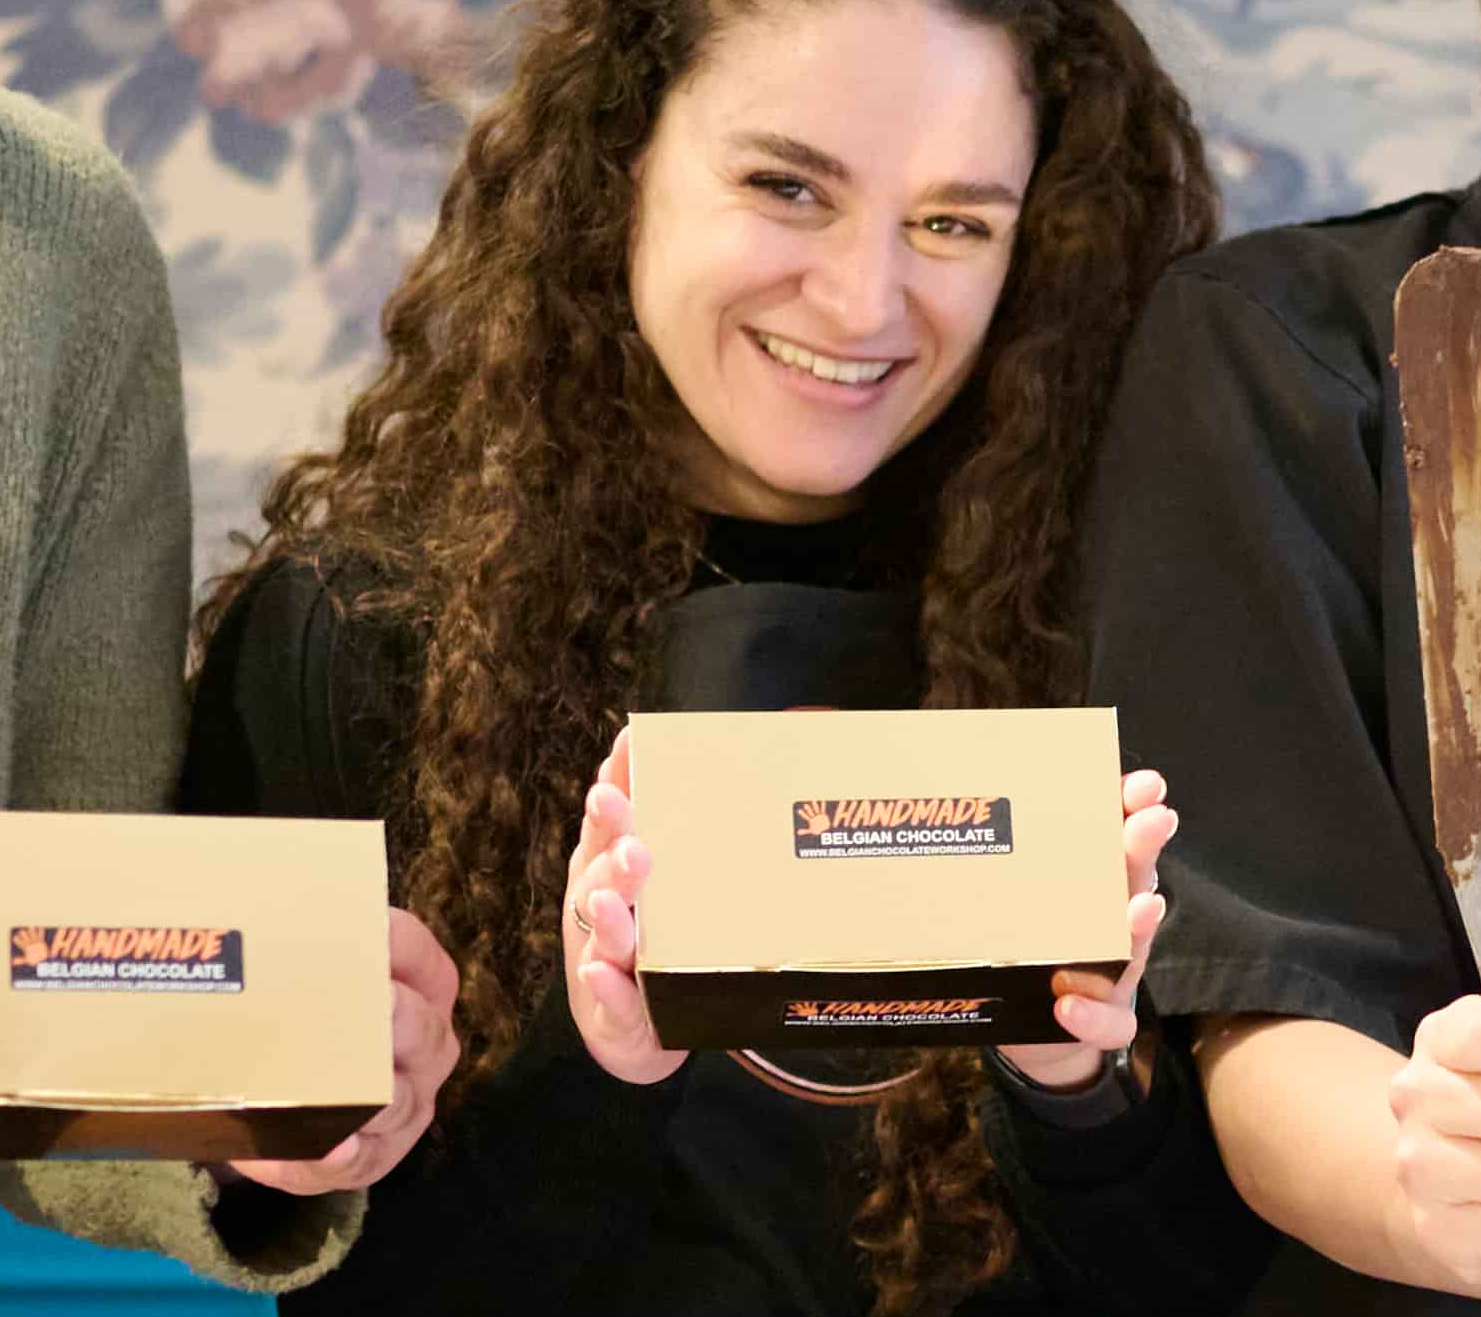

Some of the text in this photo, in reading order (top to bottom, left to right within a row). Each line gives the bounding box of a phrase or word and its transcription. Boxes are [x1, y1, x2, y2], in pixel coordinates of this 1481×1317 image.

[832, 796, 1000, 828] HANDMADE
[821, 828, 995, 845] BELGIAN CHOCOLATE
[50, 926, 227, 960] HANDMADE
[36, 961, 226, 980] BELGIAN CHOCOLATE
[822, 998, 992, 1014] HANDMADE
[807, 1013, 878, 1022] BELGIAN
[882, 1011, 980, 1022] CHOCOLATE
